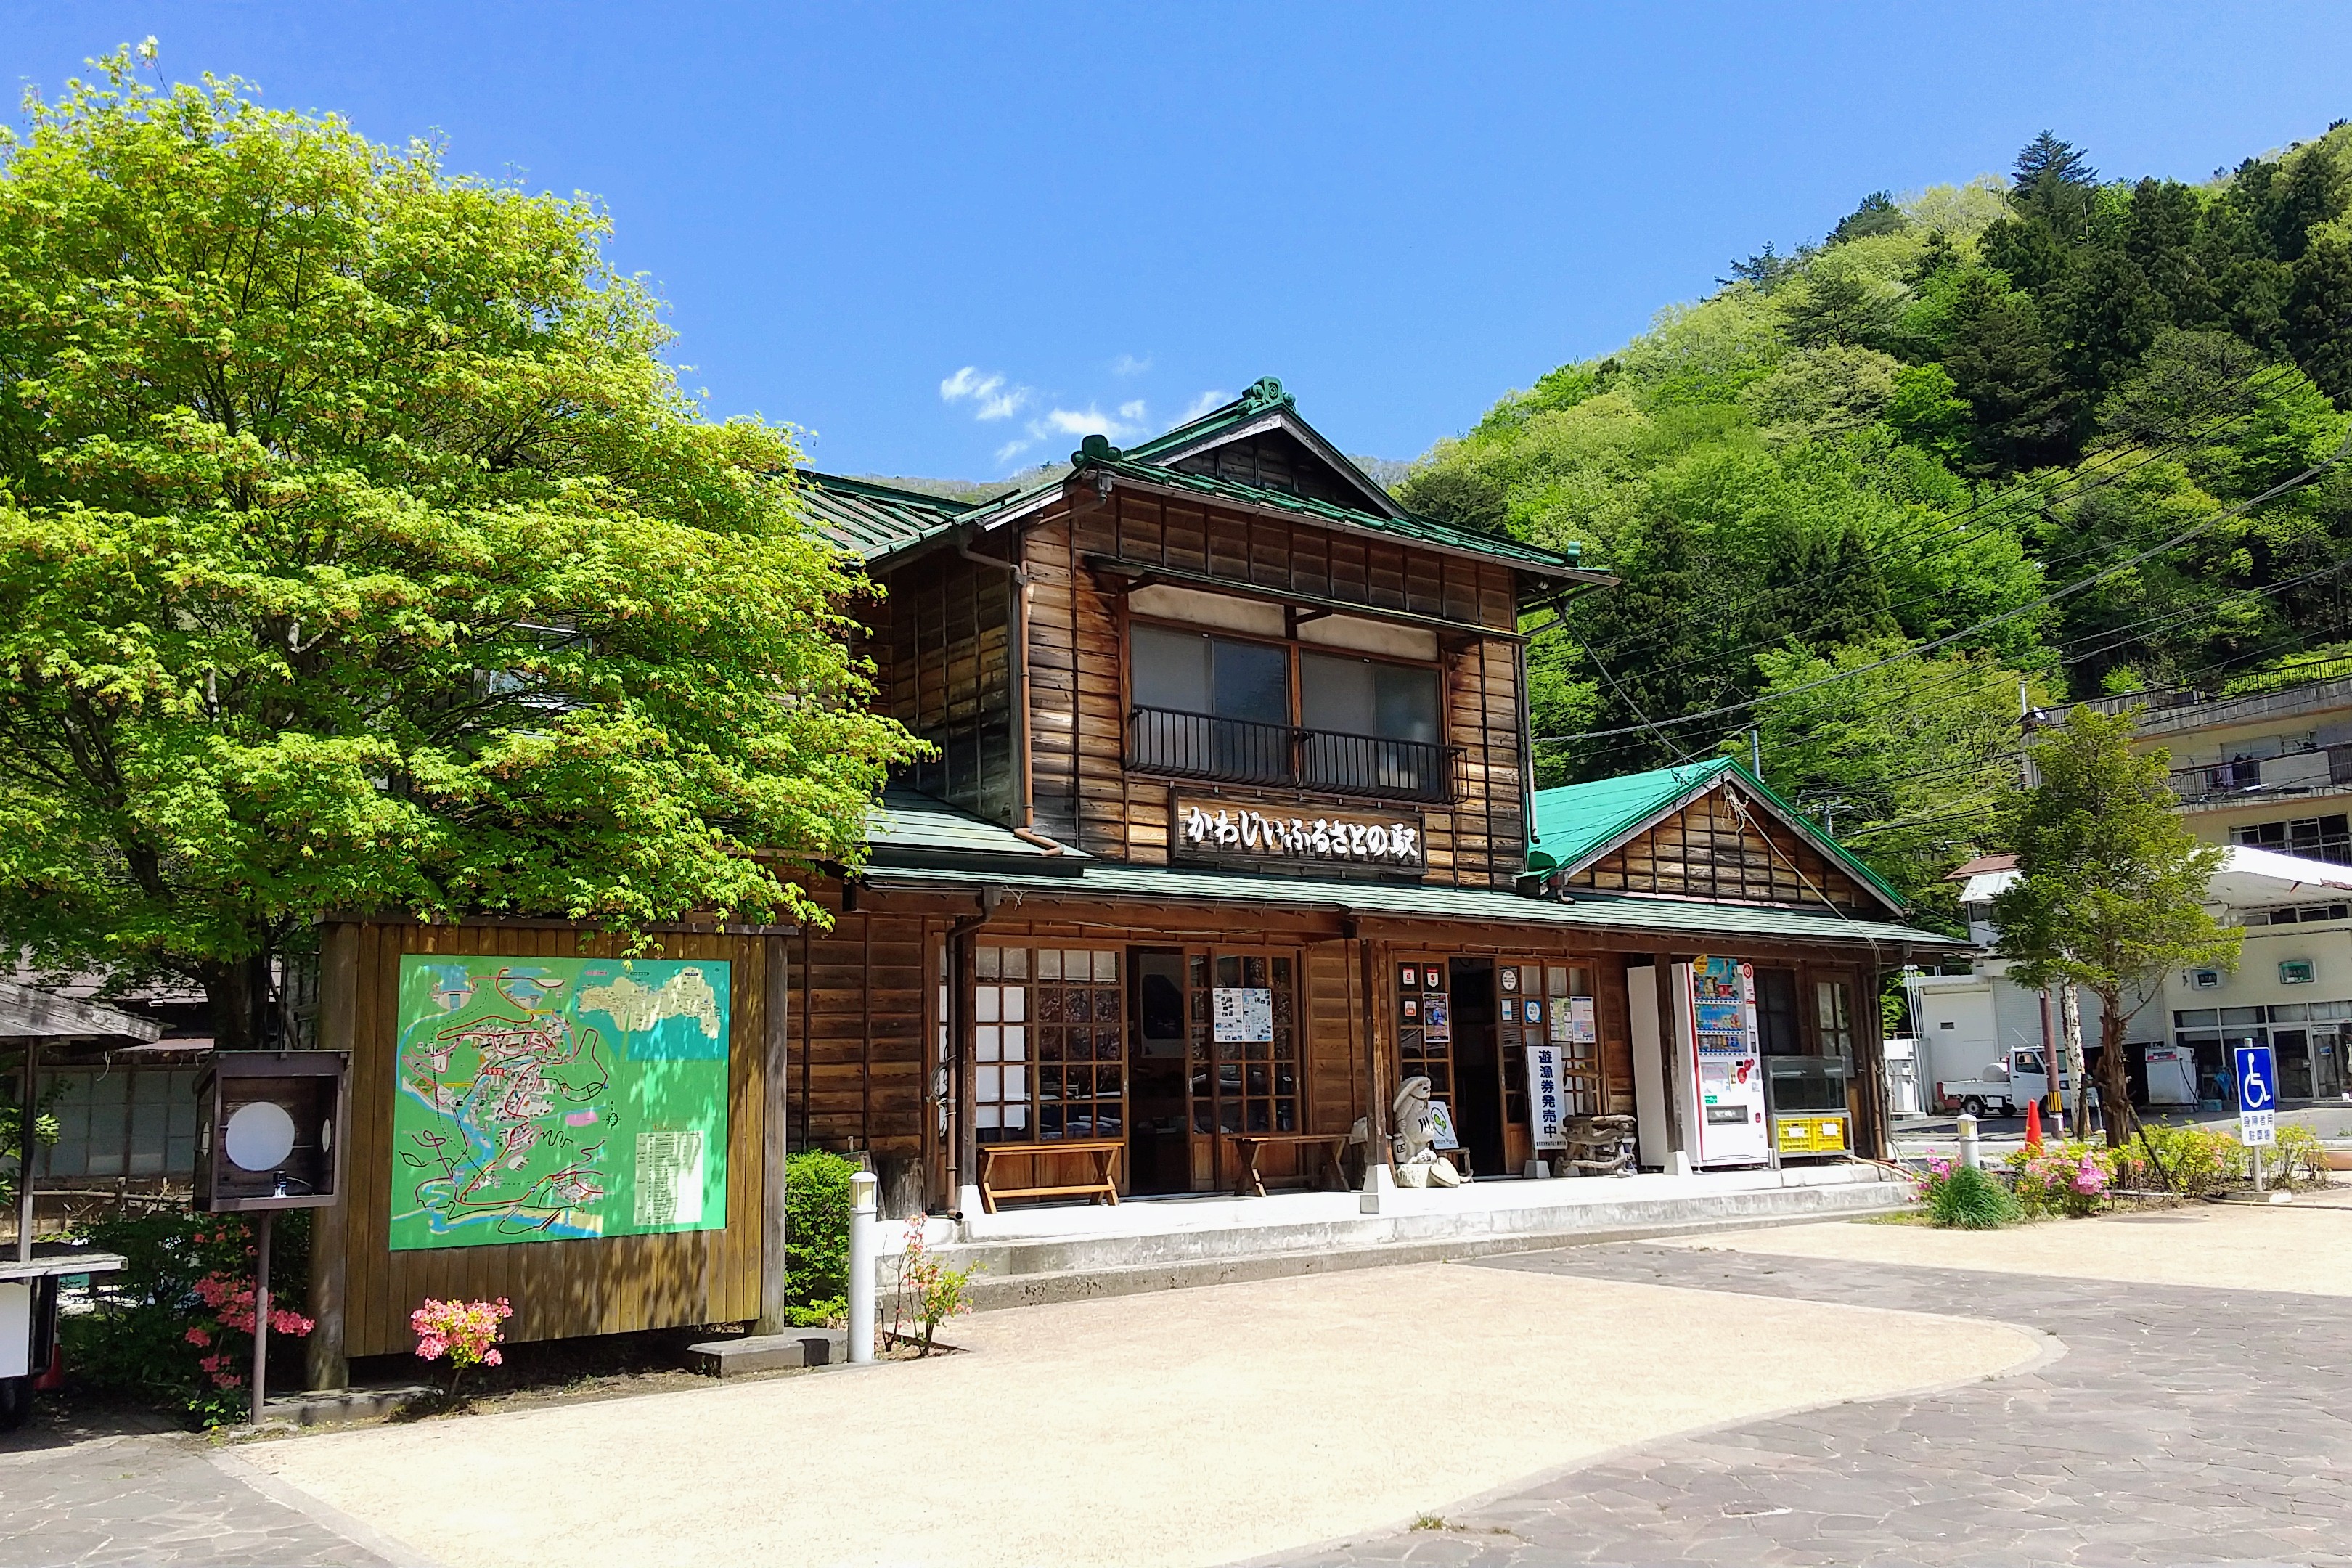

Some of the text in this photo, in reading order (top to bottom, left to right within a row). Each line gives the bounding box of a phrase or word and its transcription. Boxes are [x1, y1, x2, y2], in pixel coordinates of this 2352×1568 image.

[1187, 806, 1418, 859] かわじいふるさとの駅
[1538, 1050, 1557, 1138] 遊漁券発売中
[2243, 1114, 2274, 1127] 身障者用
[2248, 1129, 2271, 1141] 駐車場
